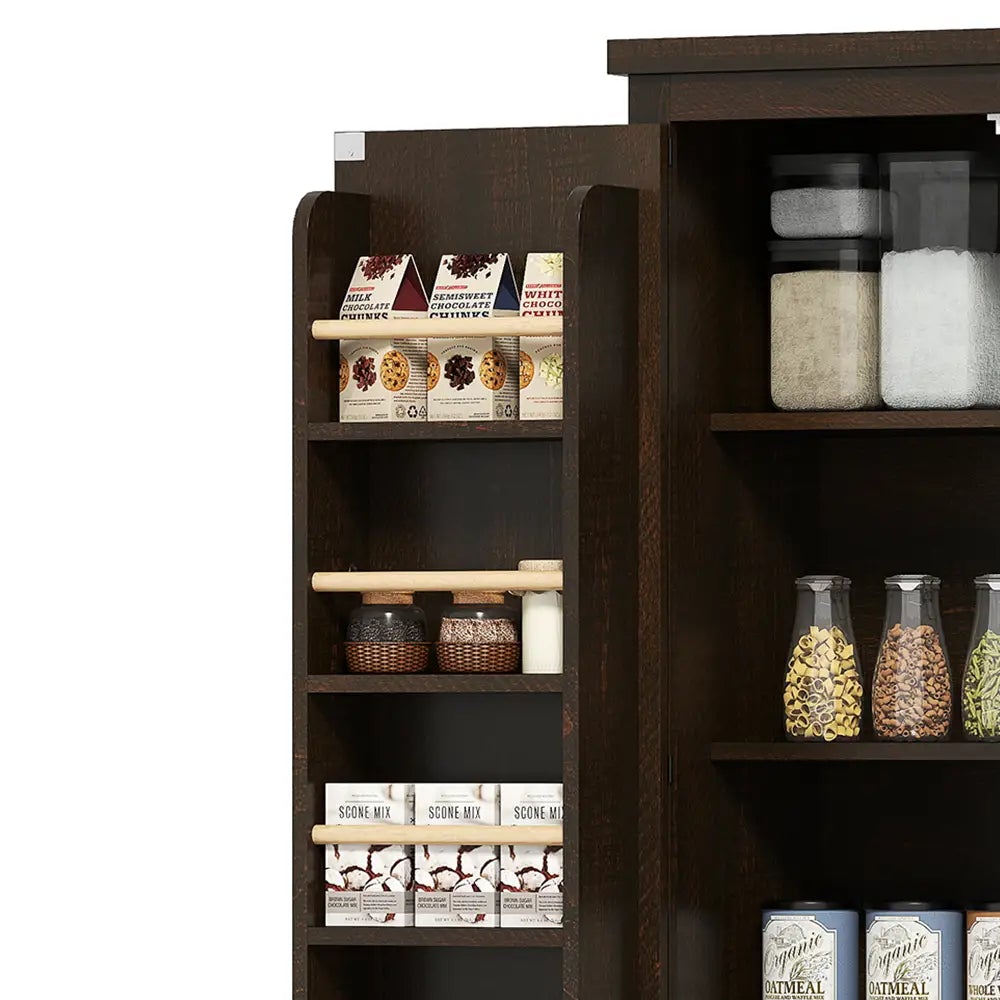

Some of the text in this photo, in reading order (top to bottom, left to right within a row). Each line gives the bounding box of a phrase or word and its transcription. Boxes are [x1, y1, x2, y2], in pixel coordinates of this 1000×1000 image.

[345, 293, 372, 302] MILK
[432, 292, 494, 301] SEMISWEET
[342, 302, 391, 312] CHOCOLATE
[430, 301, 492, 310] CHOCOLATE
[338, 805, 391, 819] SCONE MIX
[428, 805, 481, 819] SCONE MIX
[513, 805, 546, 819] SCONE
[763, 931, 823, 978] Organic
[867, 932, 927, 978] Organic
[765, 980, 825, 995] OATMEAL
[868, 981, 929, 995] OATMEAL
